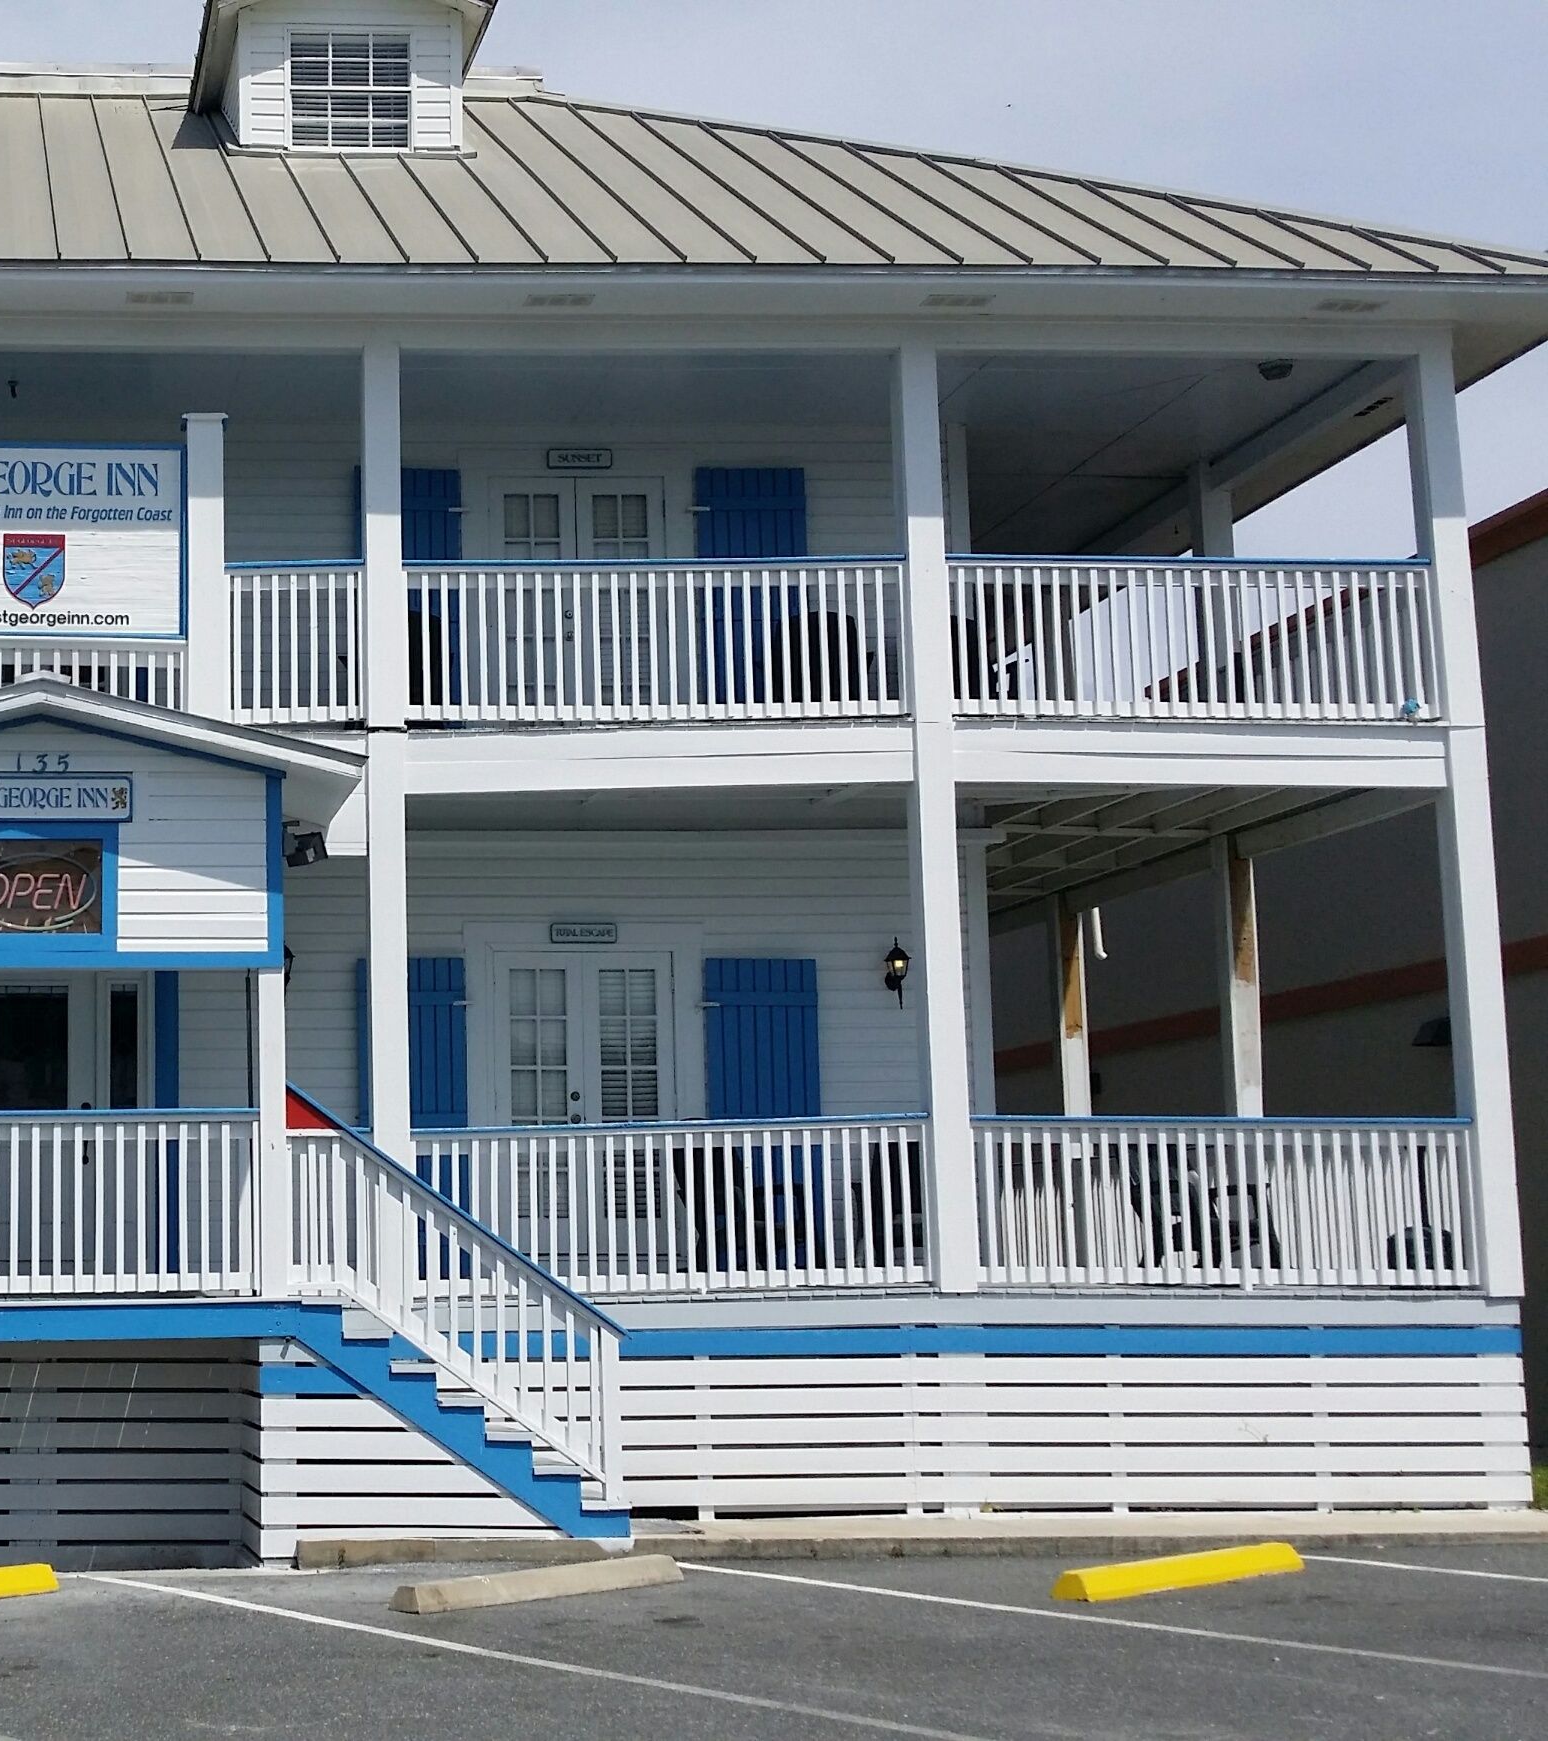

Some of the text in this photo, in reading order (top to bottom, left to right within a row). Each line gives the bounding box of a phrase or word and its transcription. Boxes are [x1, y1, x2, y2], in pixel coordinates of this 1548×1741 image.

[557, 453, 603, 463] SUNSET
[107, 462, 159, 497] INN
[4, 505, 23, 519] Inn
[26, 508, 43, 519] on
[46, 506, 68, 520] the
[71, 506, 134, 523] Forgotten
[137, 507, 173, 521] Coast
[16, 752, 71, 775] 135
[77, 787, 108, 809] INN
[580, 928, 614, 937] ESCAPE
